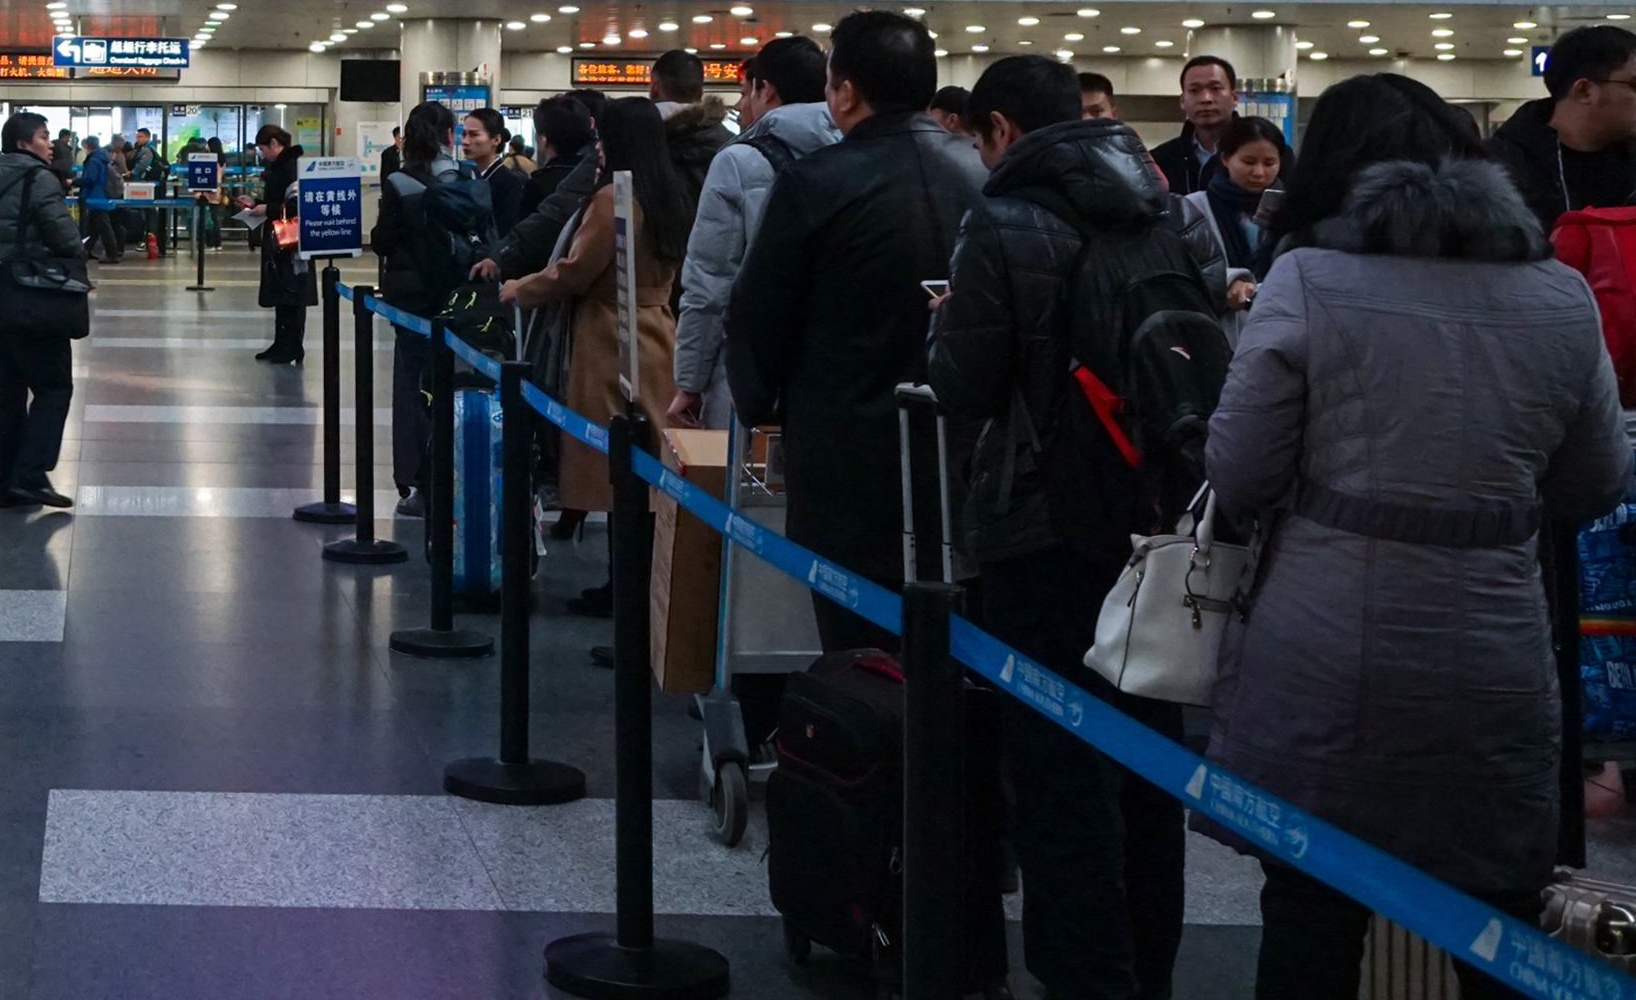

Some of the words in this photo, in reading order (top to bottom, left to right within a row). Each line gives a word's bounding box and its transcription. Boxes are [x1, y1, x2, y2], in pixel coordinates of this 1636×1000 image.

[186, 106, 198, 115] 20
[522, 109, 532, 118] 21
[197, 176, 209, 184] Exit
[304, 189, 357, 203] 请在黄线外
[320, 204, 341, 216] 等候
[305, 219, 322, 227] Please
[323, 218, 335, 226] wait
[336, 217, 356, 225] behind
[310, 229, 320, 237] the
[321, 228, 340, 238] yellow
[340, 227, 352, 236] line
